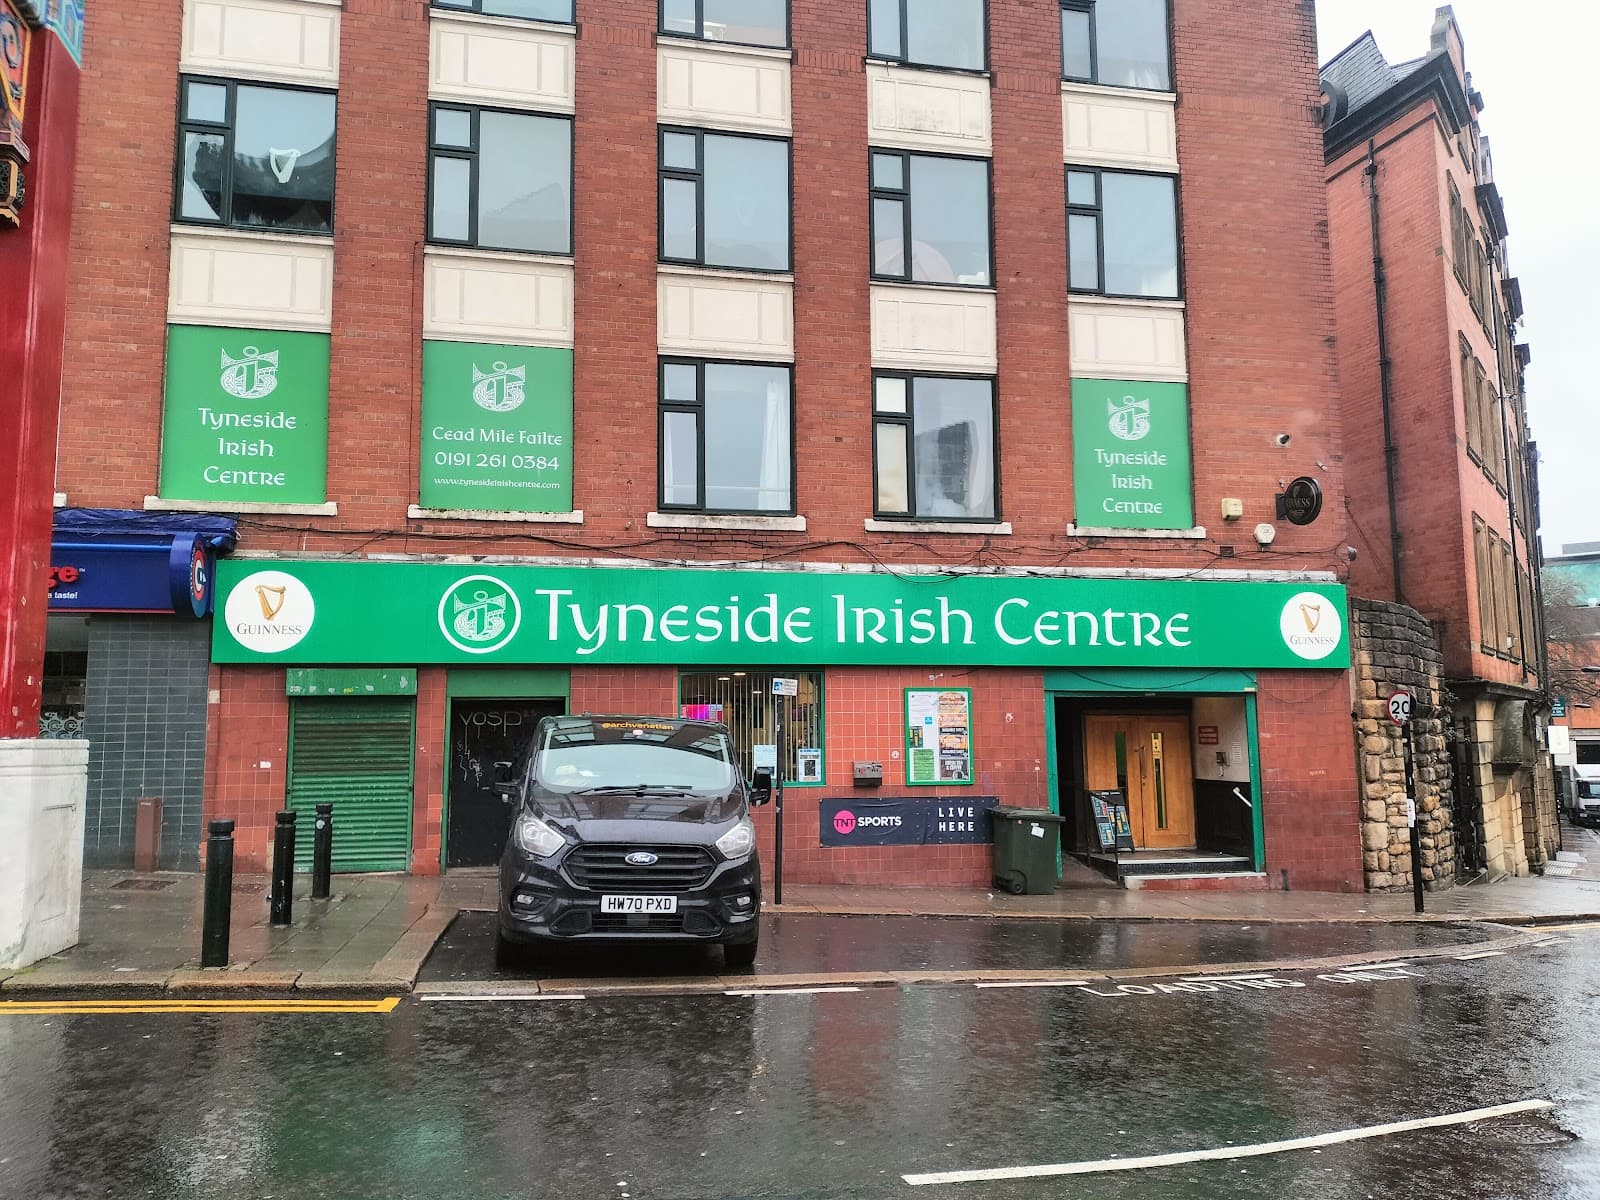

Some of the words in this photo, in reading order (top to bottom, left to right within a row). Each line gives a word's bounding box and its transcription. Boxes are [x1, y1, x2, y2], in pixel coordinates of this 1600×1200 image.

[197, 407, 297, 430] Tyneside
[432, 426, 475, 441] Cead
[479, 428, 515, 443] Mile
[518, 430, 562, 446] Failte
[217, 437, 274, 457] Irish
[434, 451, 471, 466] 0191
[476, 453, 506, 468] 261
[511, 455, 560, 470] 0384
[1094, 448, 1168, 467] Tyneside
[203, 465, 286, 486] Centre
[1111, 473, 1153, 489] Irish
[1102, 497, 1164, 514] Centre
[54, 591, 78, 600] taste!
[236, 622, 303, 636] GUINNESS
[535, 588, 814, 655] Tyneside
[831, 594, 977, 645] Irish
[994, 597, 1192, 647] Centre
[1289, 634, 1335, 646] GUINNESS
[1391, 700, 1409, 715] 20
[938, 807, 974, 818] LIVE
[833, 818, 856, 828] TNT
[857, 816, 902, 827] SPORTS
[938, 821, 975, 832] HERE
[608, 897, 643, 910] HW70
[646, 898, 672, 910] PXD
